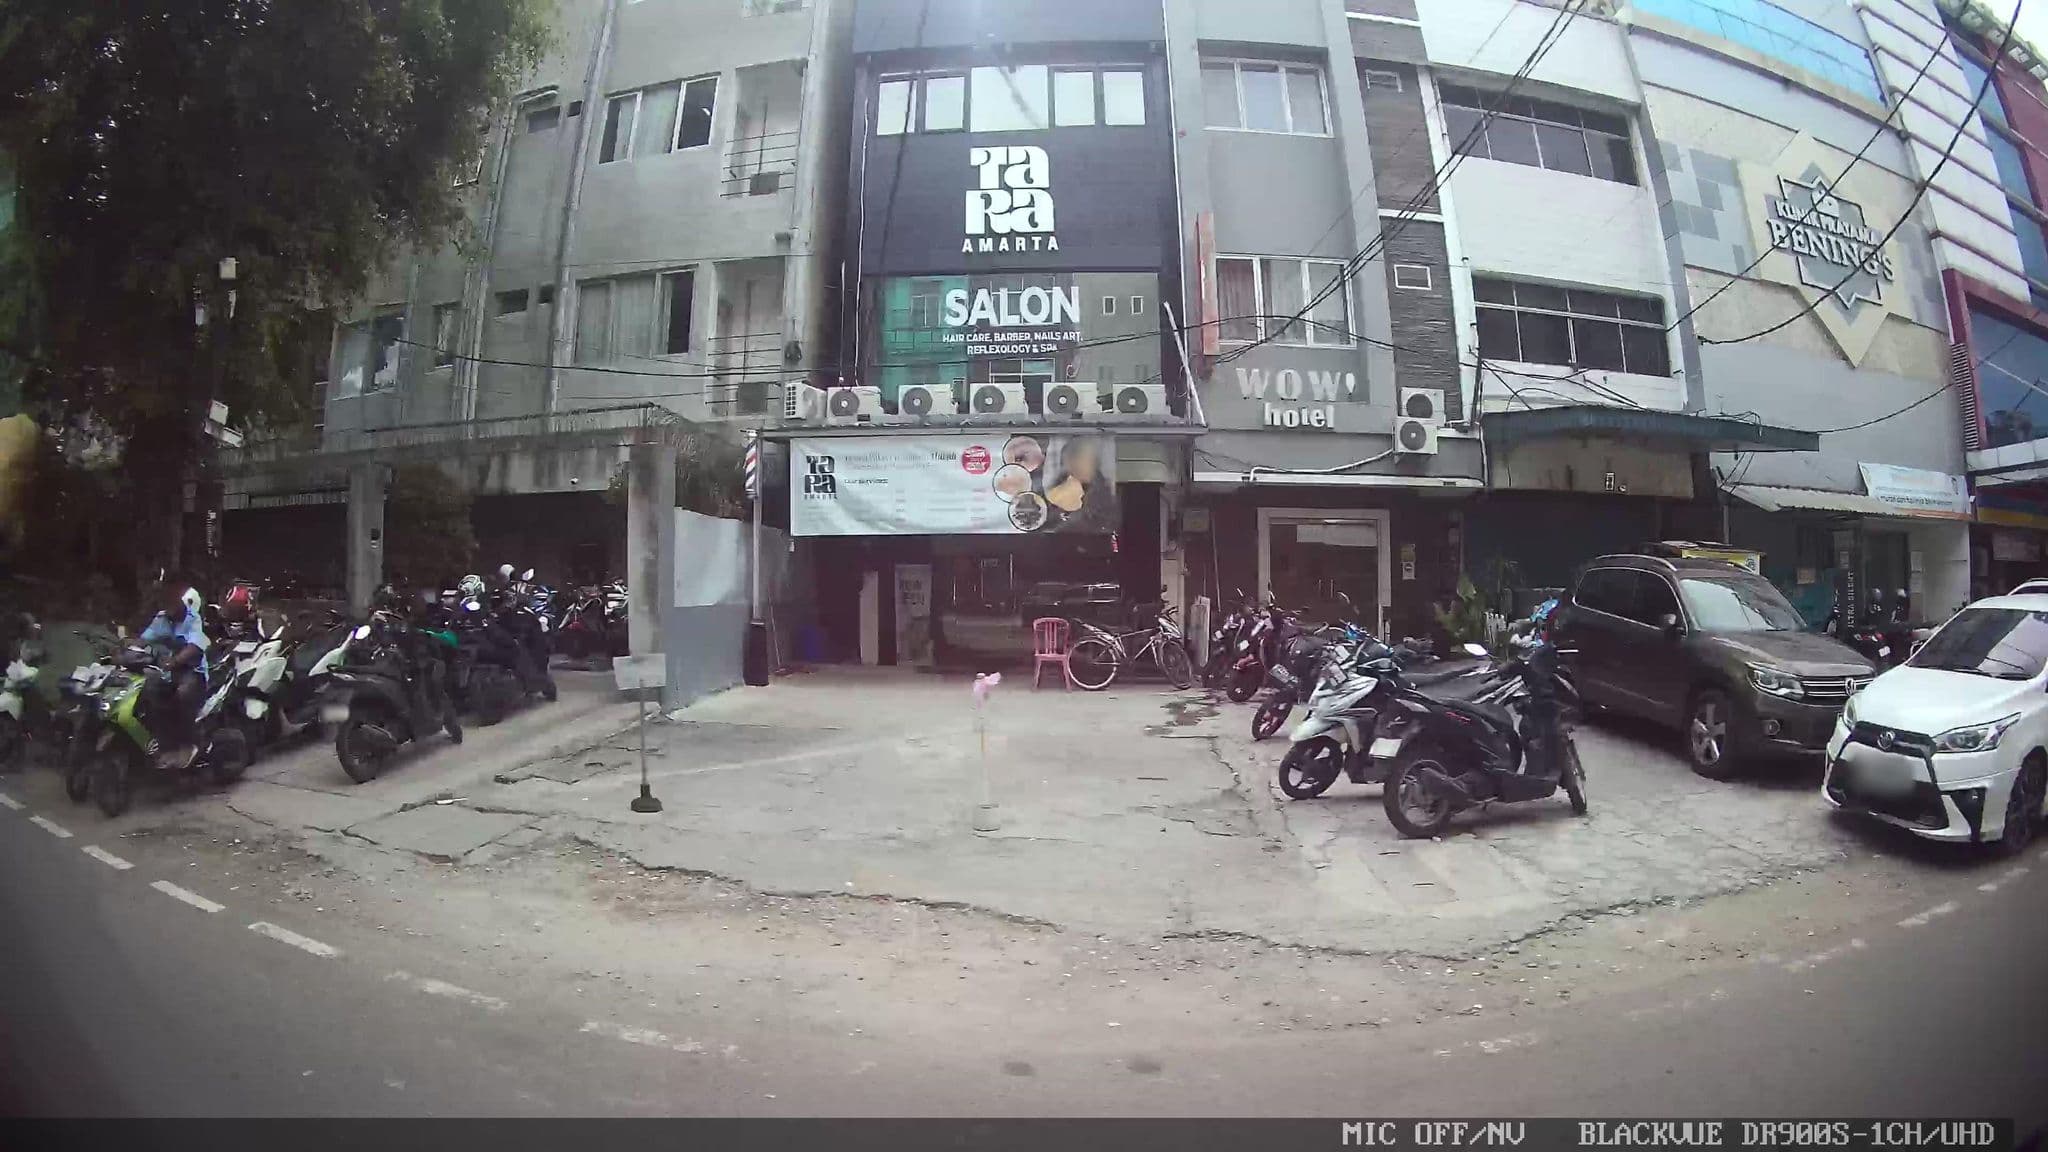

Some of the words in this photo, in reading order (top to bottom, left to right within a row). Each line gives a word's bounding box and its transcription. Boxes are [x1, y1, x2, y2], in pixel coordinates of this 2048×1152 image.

[961, 236, 1059, 253] AMARTA
[1767, 219, 1895, 281] BENING'S
[944, 286, 1080, 327] SALON
[942, 333, 965, 343] HAIR
[1034, 331, 1061, 341] NAILS
[967, 344, 1031, 355] REFLEXOLOGY
[1032, 344, 1039, 353] &
[1040, 343, 1058, 353] SPA
[1236, 368, 1356, 402] WOW!
[1264, 402, 1335, 429] hotel
